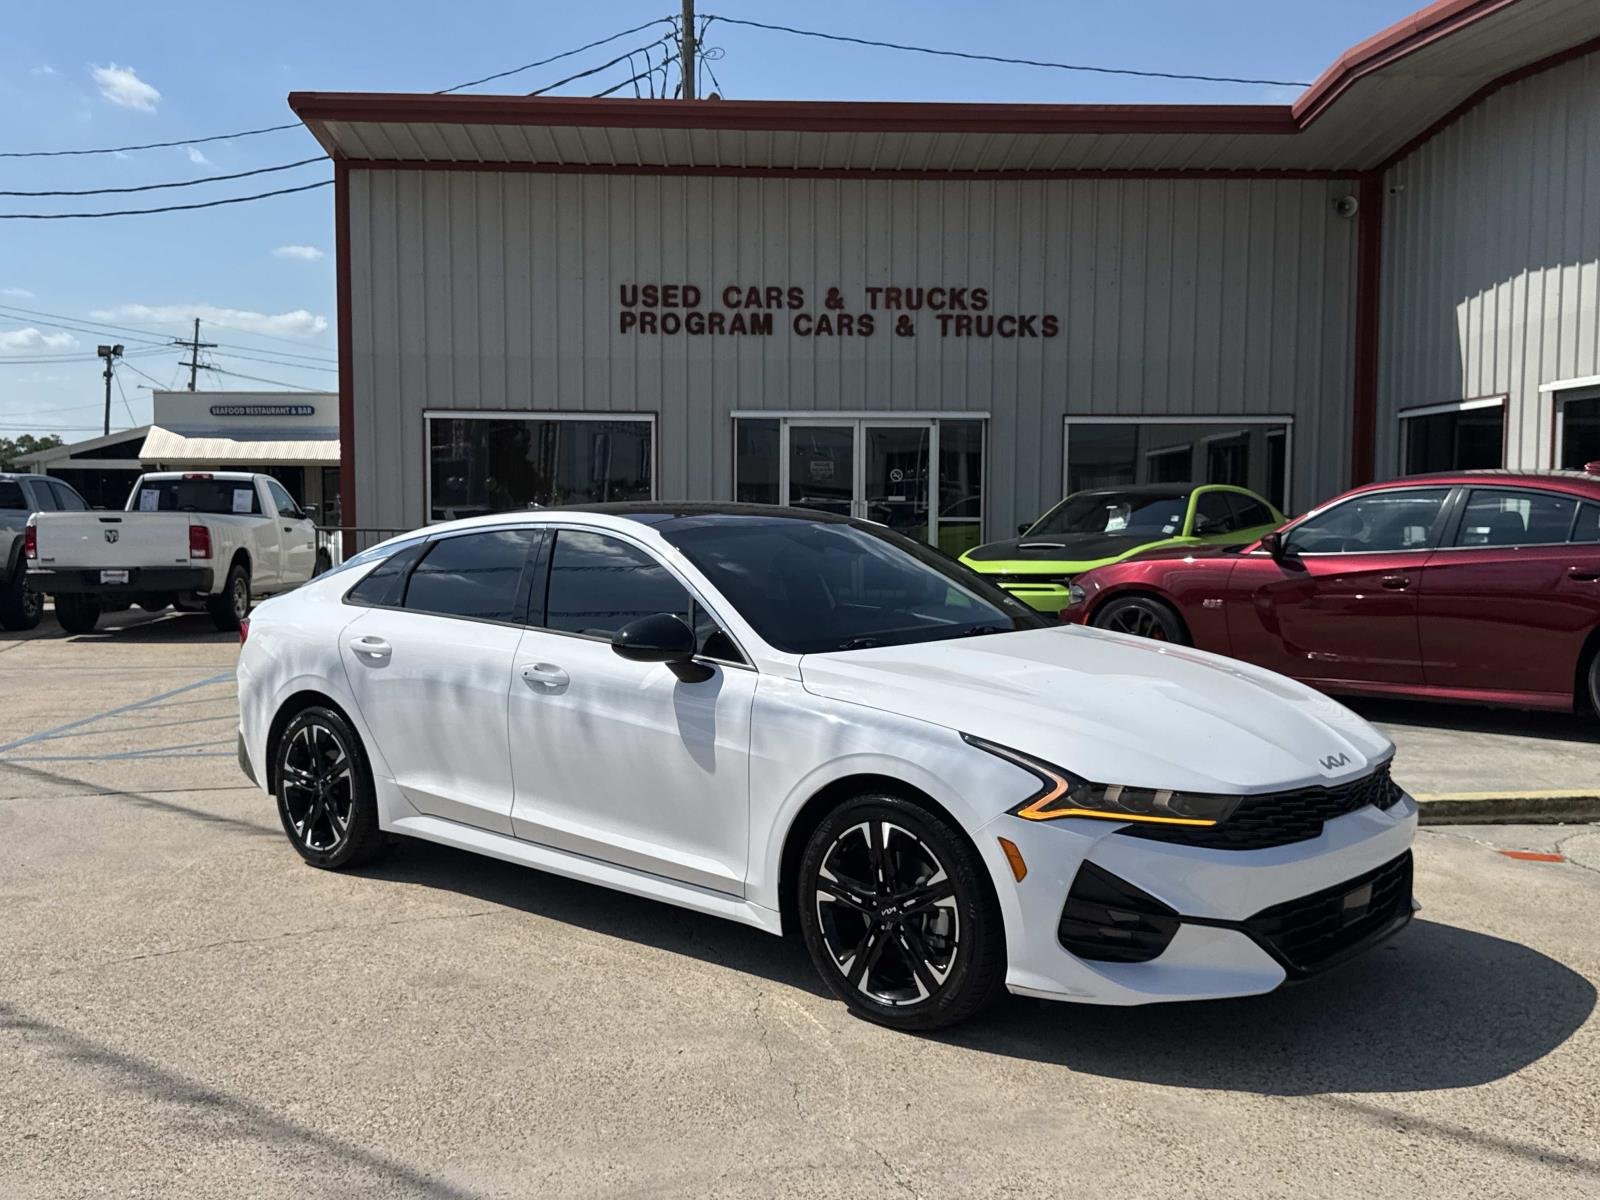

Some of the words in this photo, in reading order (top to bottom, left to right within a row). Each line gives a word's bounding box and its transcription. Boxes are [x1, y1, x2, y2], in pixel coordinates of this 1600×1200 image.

[619, 284, 701, 308] USED
[722, 286, 804, 310] CARS
[824, 287, 845, 310] &
[865, 287, 988, 311] TRUCKS
[619, 311, 773, 335] PROGRAM
[793, 313, 875, 336] CARS
[895, 314, 915, 337] &
[936, 314, 1059, 338] TRUCKS
[211, 407, 245, 415] SEAFOOD
[245, 407, 290, 415] RESTAURANT
[290, 407, 297, 415] &
[297, 407, 312, 415] BAR
